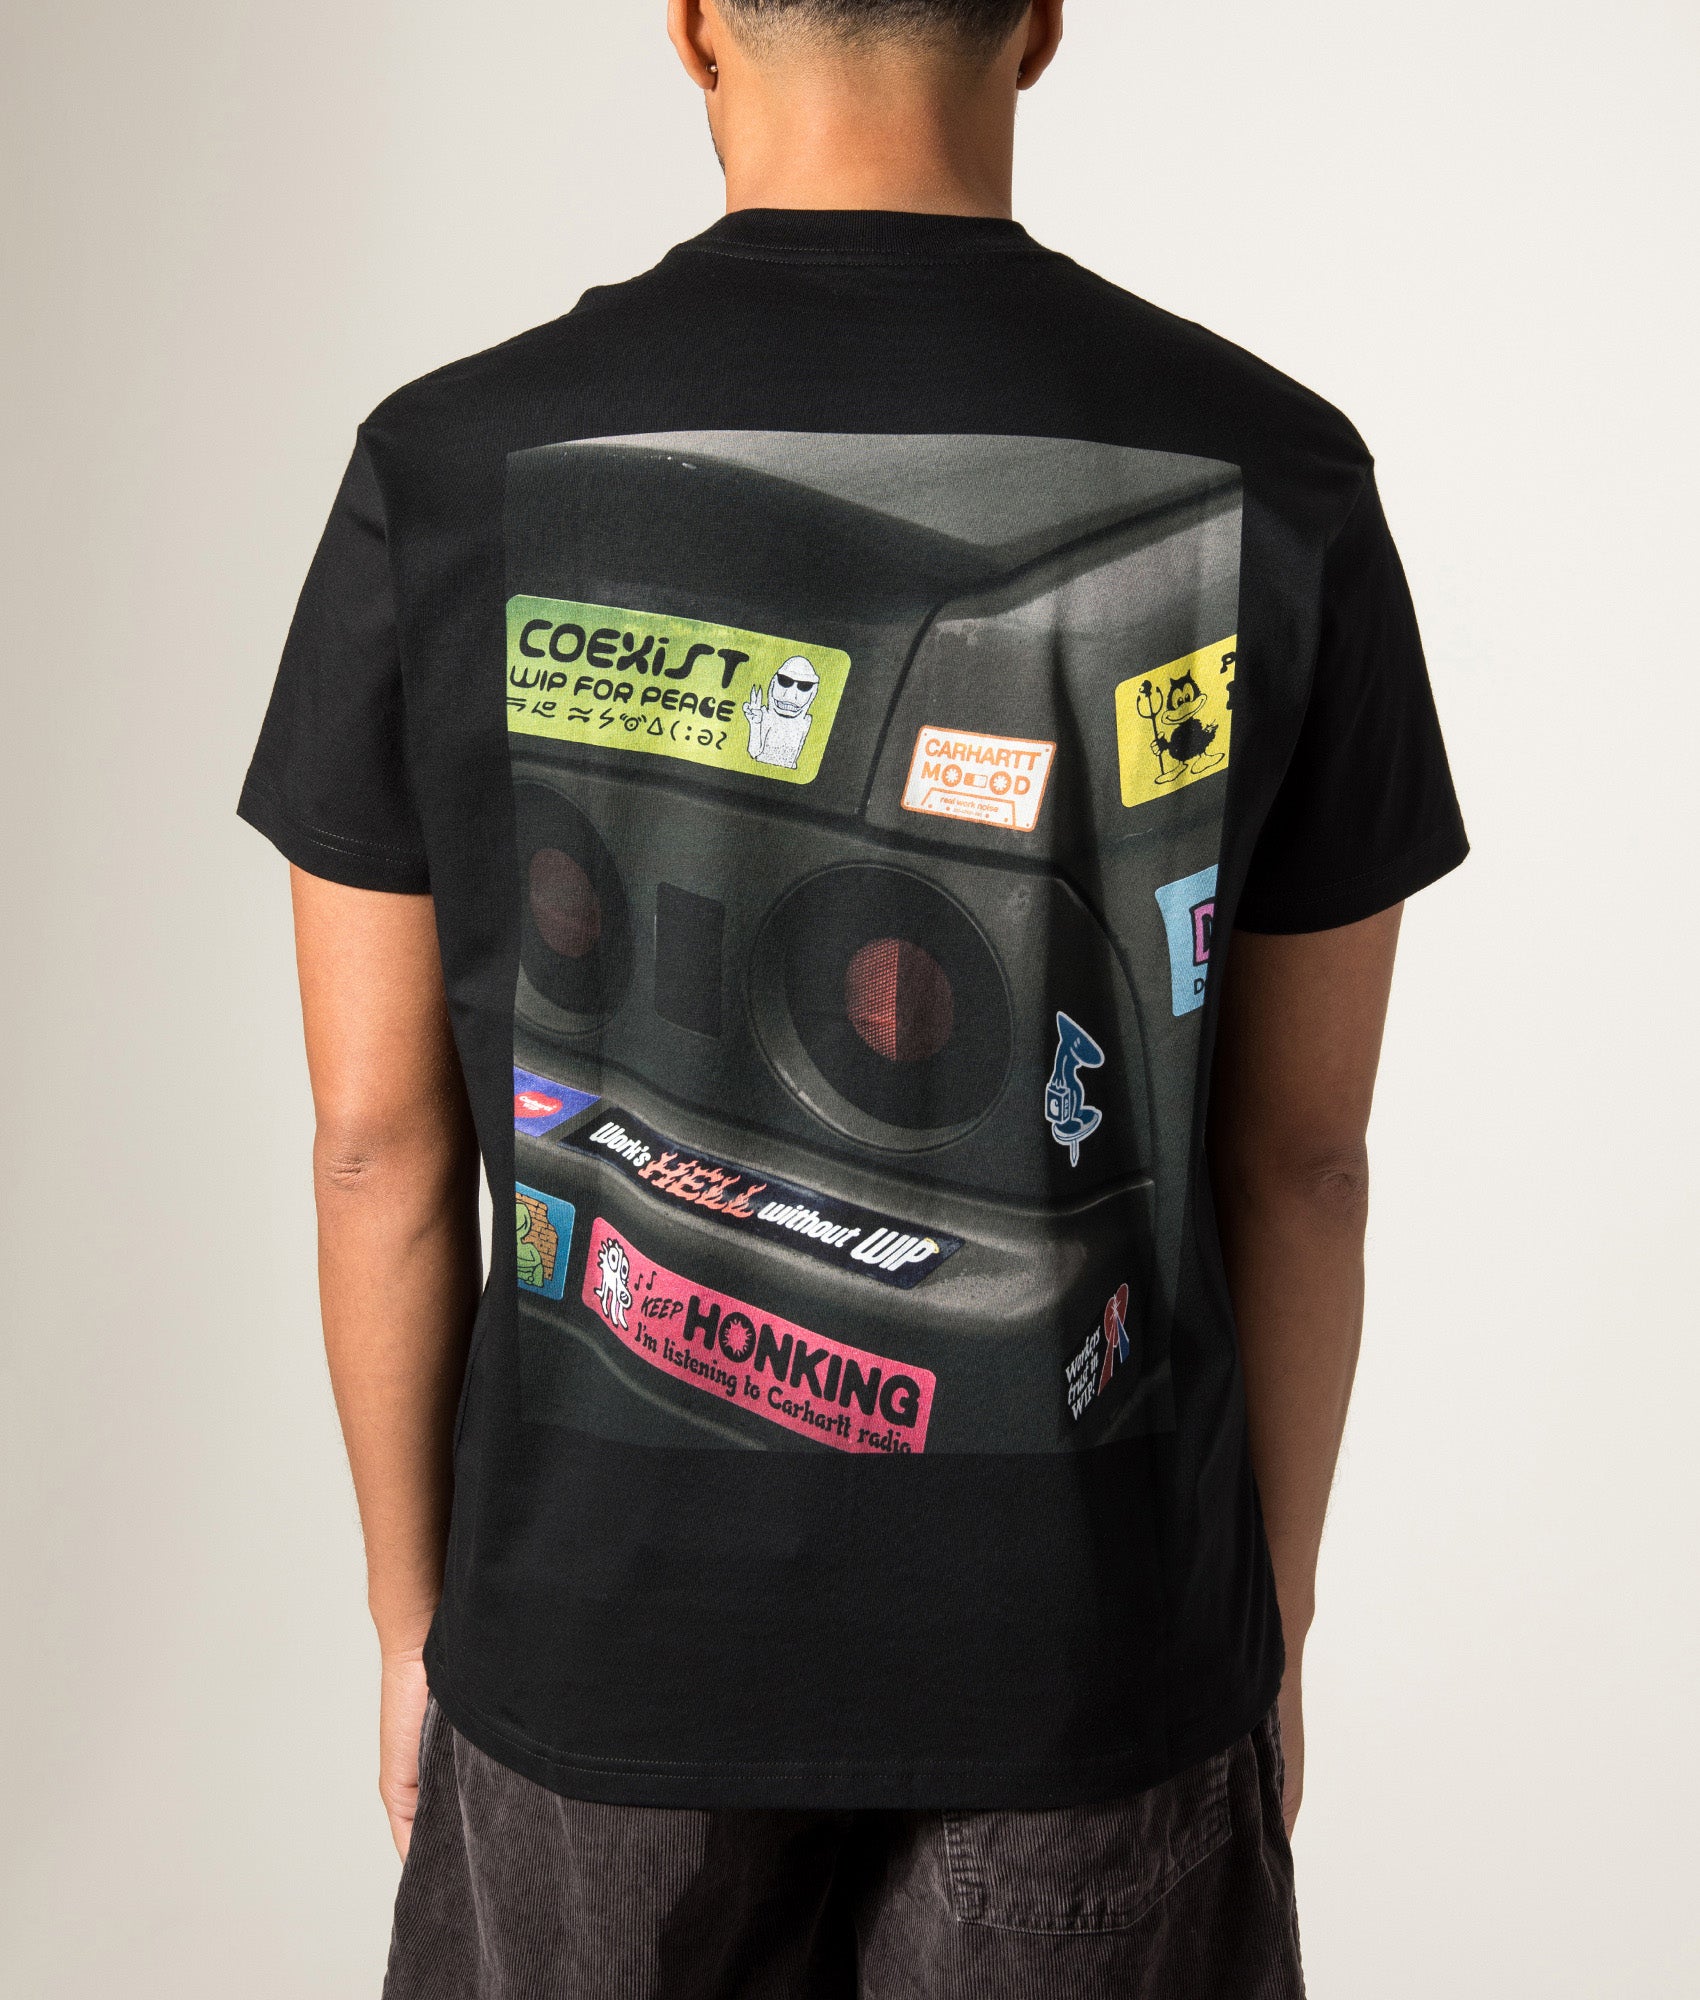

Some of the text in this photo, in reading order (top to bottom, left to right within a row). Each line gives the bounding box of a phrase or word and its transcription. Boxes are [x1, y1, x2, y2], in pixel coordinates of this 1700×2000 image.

[510, 666, 736, 722] WIP FOR PEACE
[925, 738, 1041, 771] CARHARTT
[589, 1121, 937, 1272] Work's HELL without WIP
[635, 1321, 657, 1353] I'm
[663, 1337, 738, 1397] listening
[743, 1375, 760, 1400] to
[767, 1386, 852, 1438] Carhartt
[641, 1295, 921, 1428] KEEP HONKING
